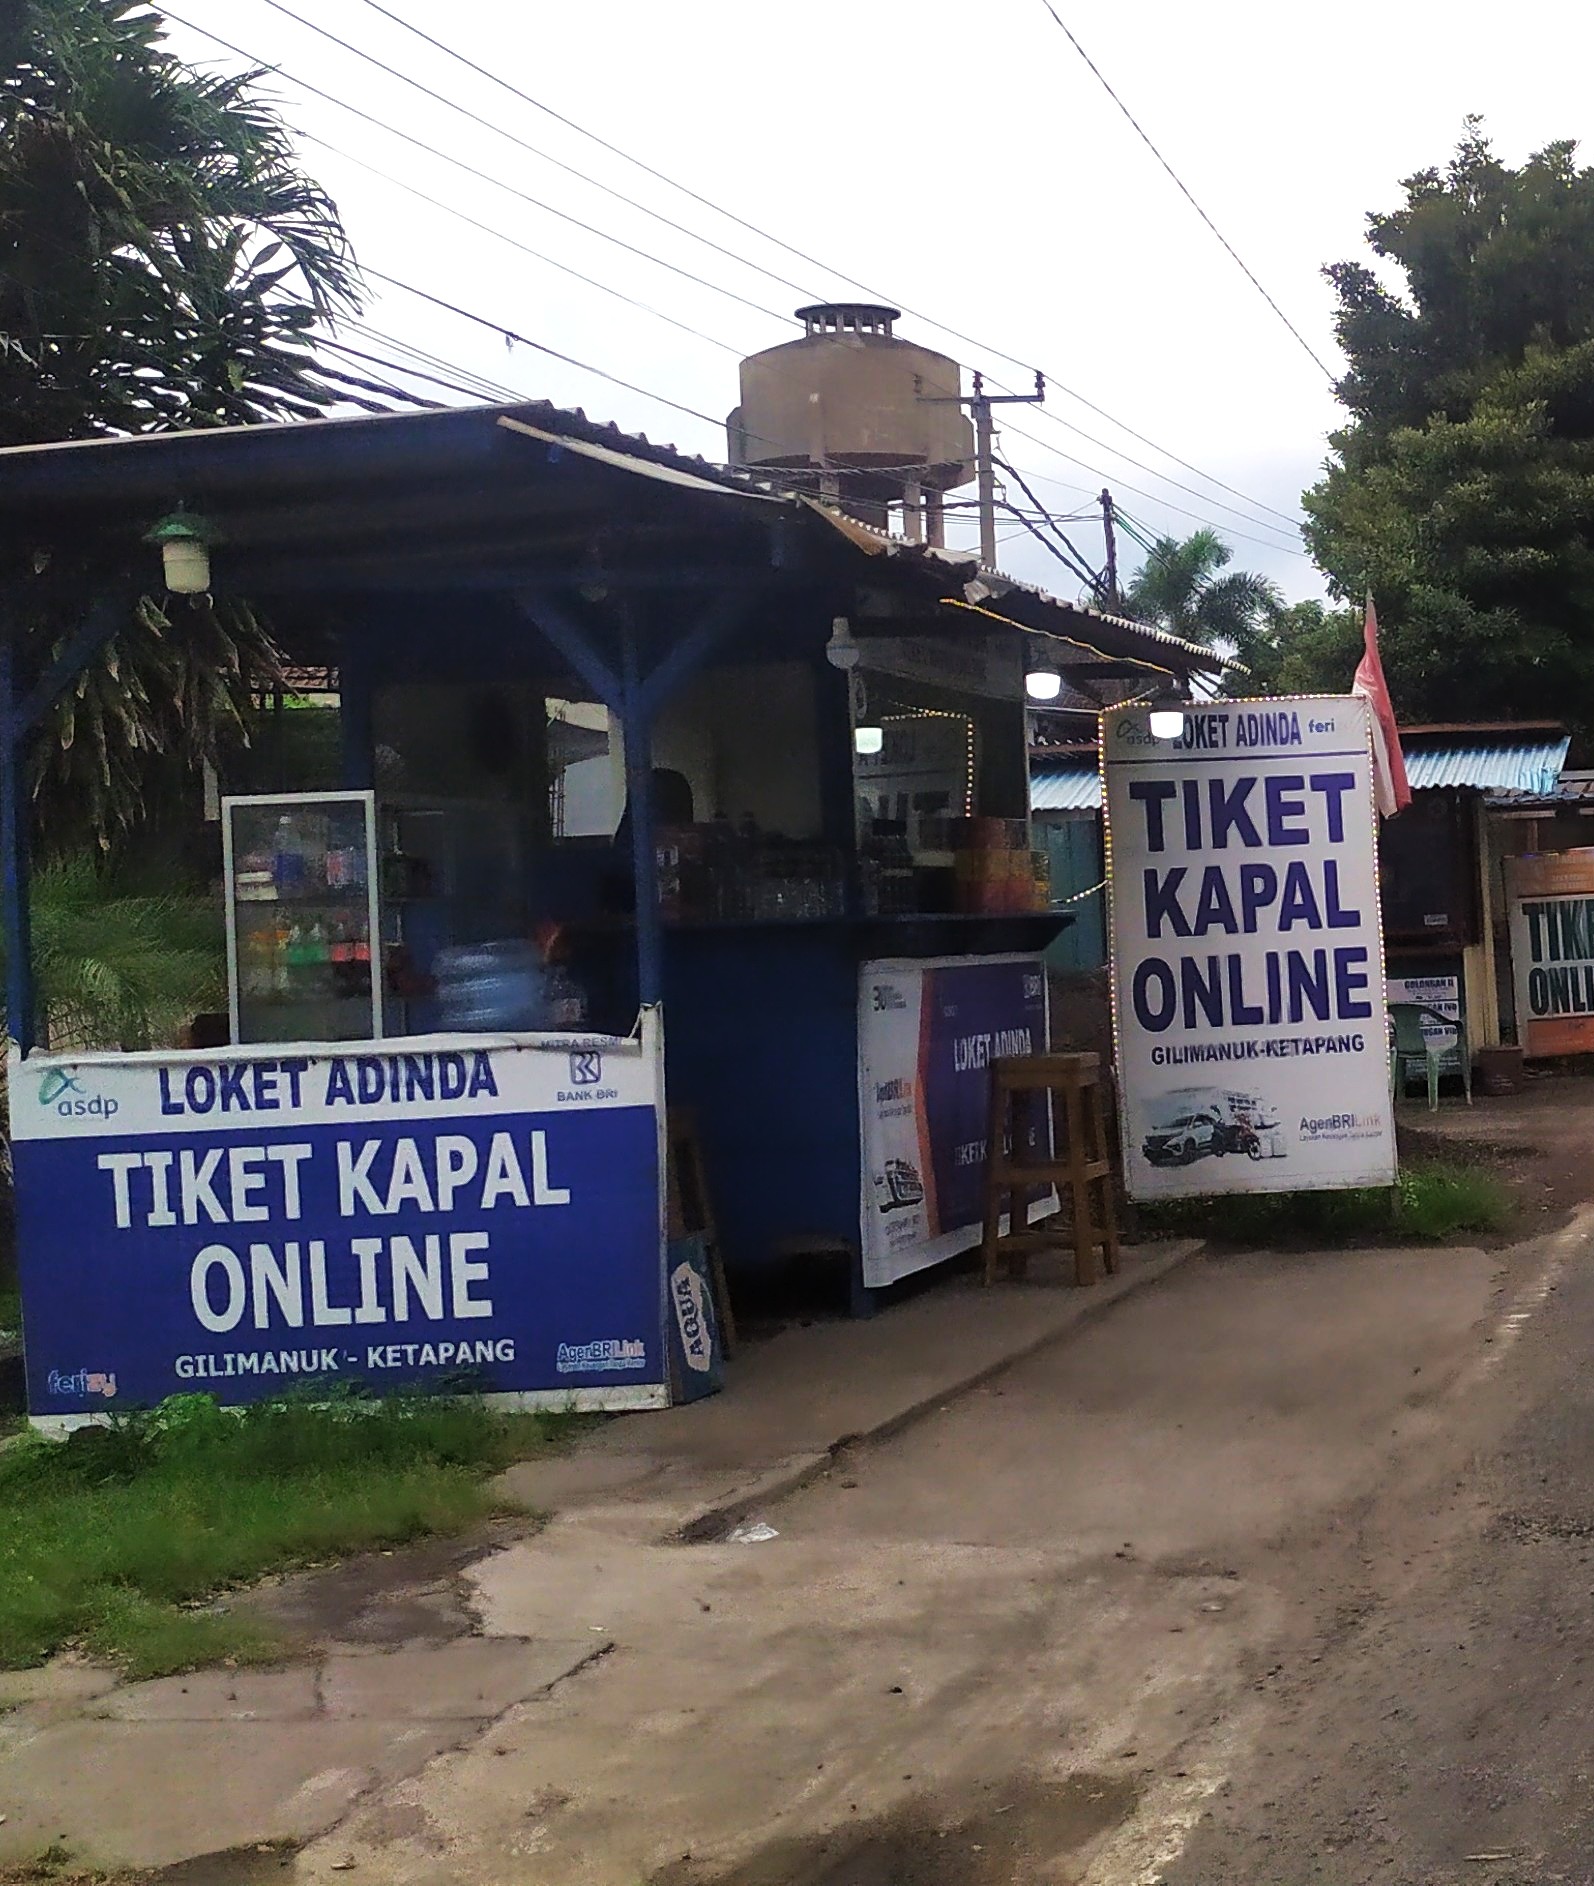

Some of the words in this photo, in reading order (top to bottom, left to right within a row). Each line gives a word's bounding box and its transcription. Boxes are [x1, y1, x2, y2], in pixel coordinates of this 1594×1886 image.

[1173, 714, 1229, 749] OKET
[1236, 711, 1302, 747] ADINDA
[1129, 772, 1355, 852] TIKET
[1144, 859, 1361, 938] KAPAL
[1132, 946, 1372, 1032] ONLINE
[159, 1059, 308, 1115] LOKET
[325, 1050, 499, 1106] ADINDA
[955, 1033, 992, 1073] LOKET
[58, 1092, 118, 1119] asdp
[557, 1090, 592, 1102] BANK
[597, 1088, 618, 1099] BRI
[97, 1143, 313, 1229] TIKET
[336, 1130, 570, 1217] KAPAL
[190, 1231, 494, 1333] ONLINE
[175, 1348, 339, 1378] GILIMANUK
[367, 1339, 515, 1369] KETAPANG
